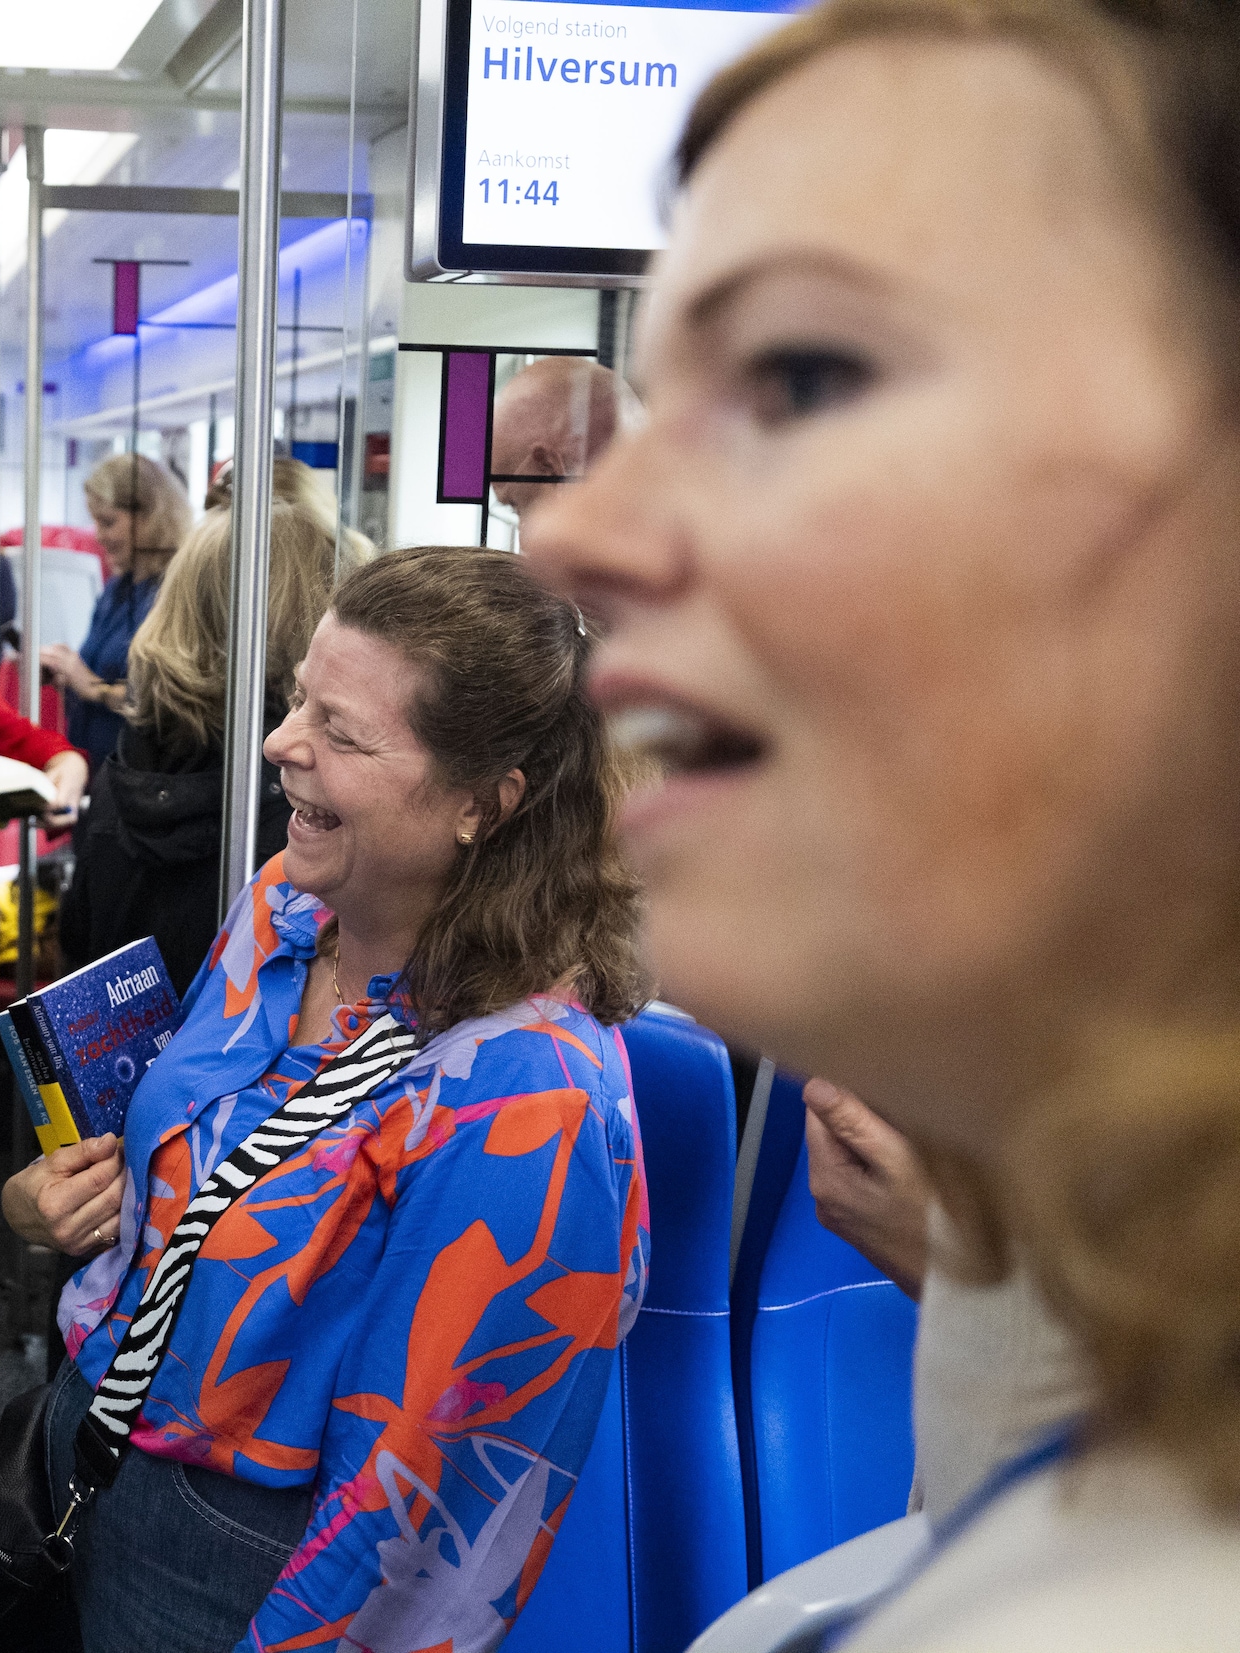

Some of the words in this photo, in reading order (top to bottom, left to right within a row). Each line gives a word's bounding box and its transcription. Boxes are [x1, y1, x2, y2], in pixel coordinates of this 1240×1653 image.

[482, 15, 558, 39] Volgend
[565, 20, 627, 38] station
[483, 46, 678, 87] Hilversum
[477, 149, 570, 169] Aankomst
[479, 178, 559, 206] 11:44
[105, 965, 160, 1008] Adriaan
[33, 1005, 50, 1037] Adriaan
[46, 1038, 58, 1055] van
[53, 1054, 64, 1070] Dis
[67, 1010, 100, 1036] naar
[75, 989, 174, 1067] zachtheid
[153, 1029, 174, 1051] van
[8, 1025, 20, 1045] ROB
[17, 1047, 29, 1067] VAN
[24, 1068, 39, 1095] ESSEN
[35, 1050, 50, 1080] sacha
[97, 1087, 117, 1107] en
